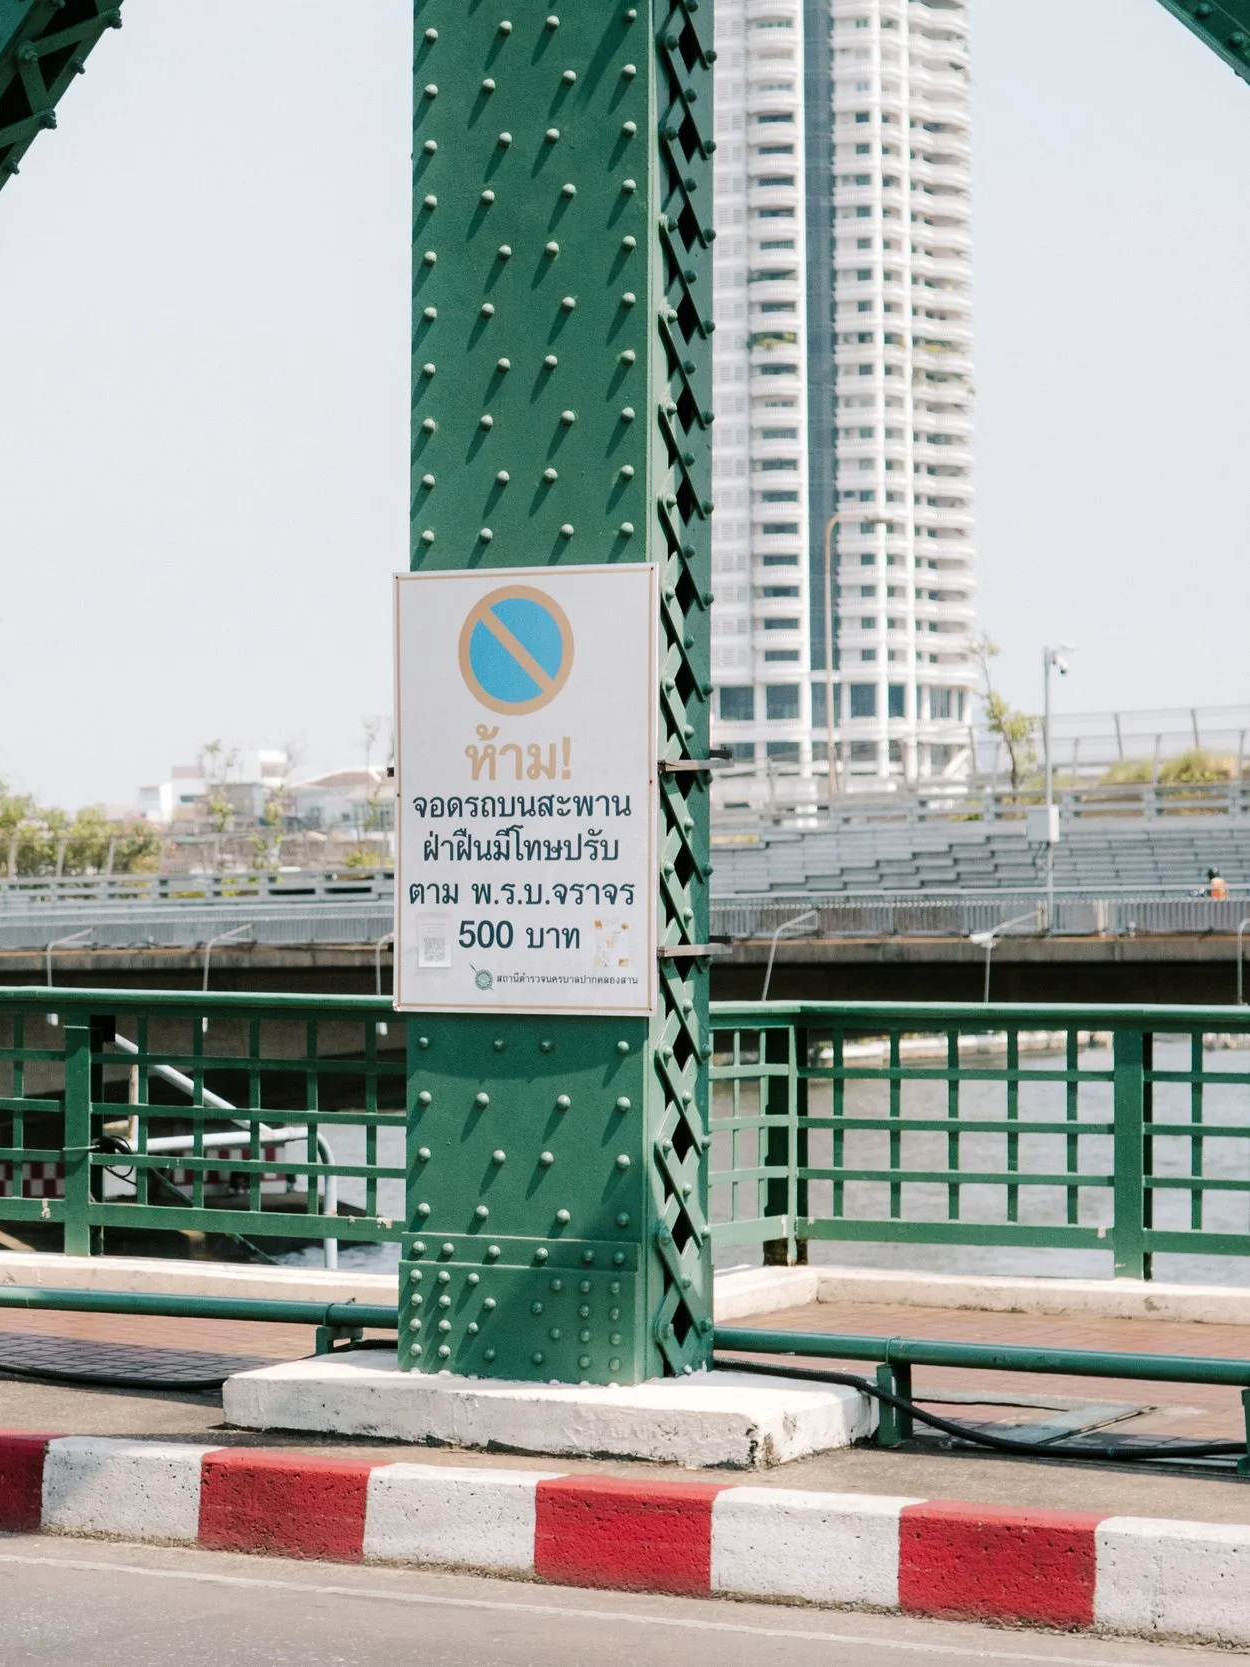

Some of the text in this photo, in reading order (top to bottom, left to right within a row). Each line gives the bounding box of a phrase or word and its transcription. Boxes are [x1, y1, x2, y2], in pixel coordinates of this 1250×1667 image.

[464, 723, 571, 781] ห้าม!
[412, 793, 632, 819] จอดรถบนสะพาน
[423, 824, 619, 862] ฝ่าฝืนมีโทษปรับ
[408, 882, 636, 906] ตาม พ.ร.บ.จราจร
[458, 919, 581, 950] 500 บาท
